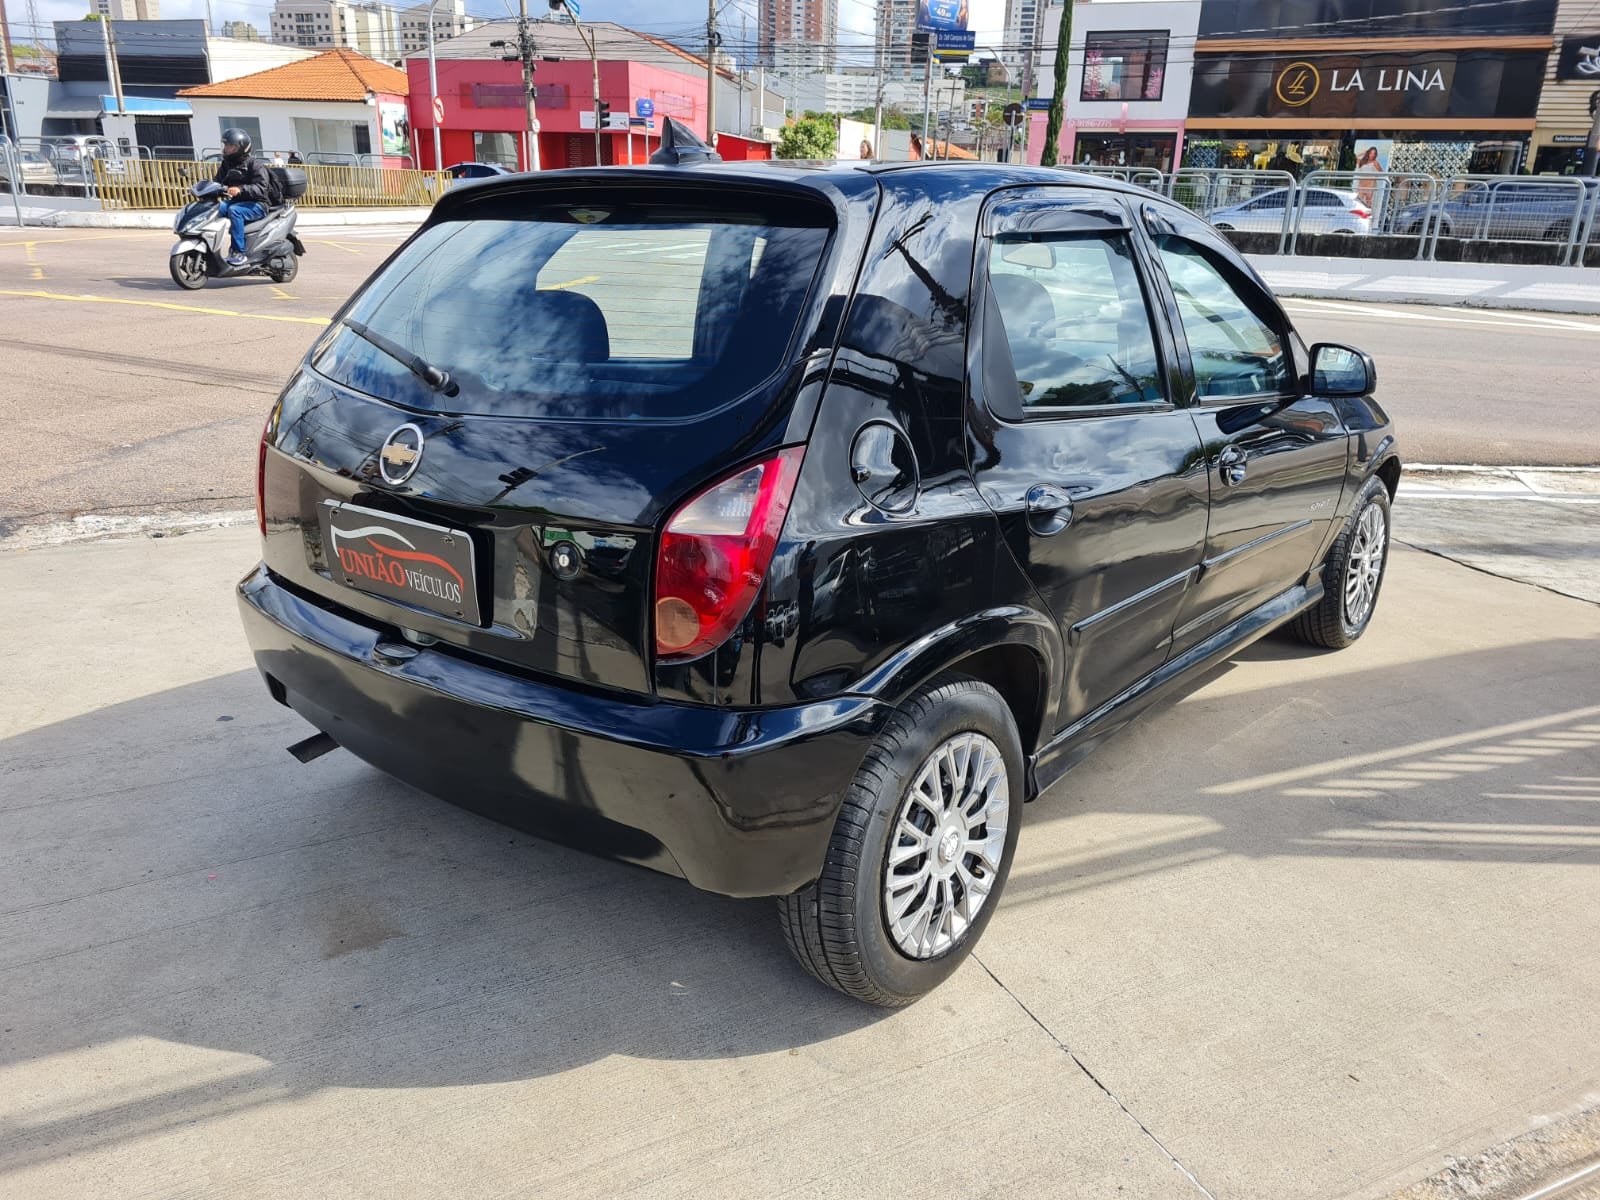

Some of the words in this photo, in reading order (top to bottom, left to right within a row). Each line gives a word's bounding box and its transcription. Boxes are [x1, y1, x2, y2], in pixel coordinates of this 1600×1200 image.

[1330, 69, 1365, 92] LA
[1377, 68, 1446, 91] LINA
[338, 547, 406, 588] UNIÃO
[405, 569, 461, 604] VEÍCULOS
